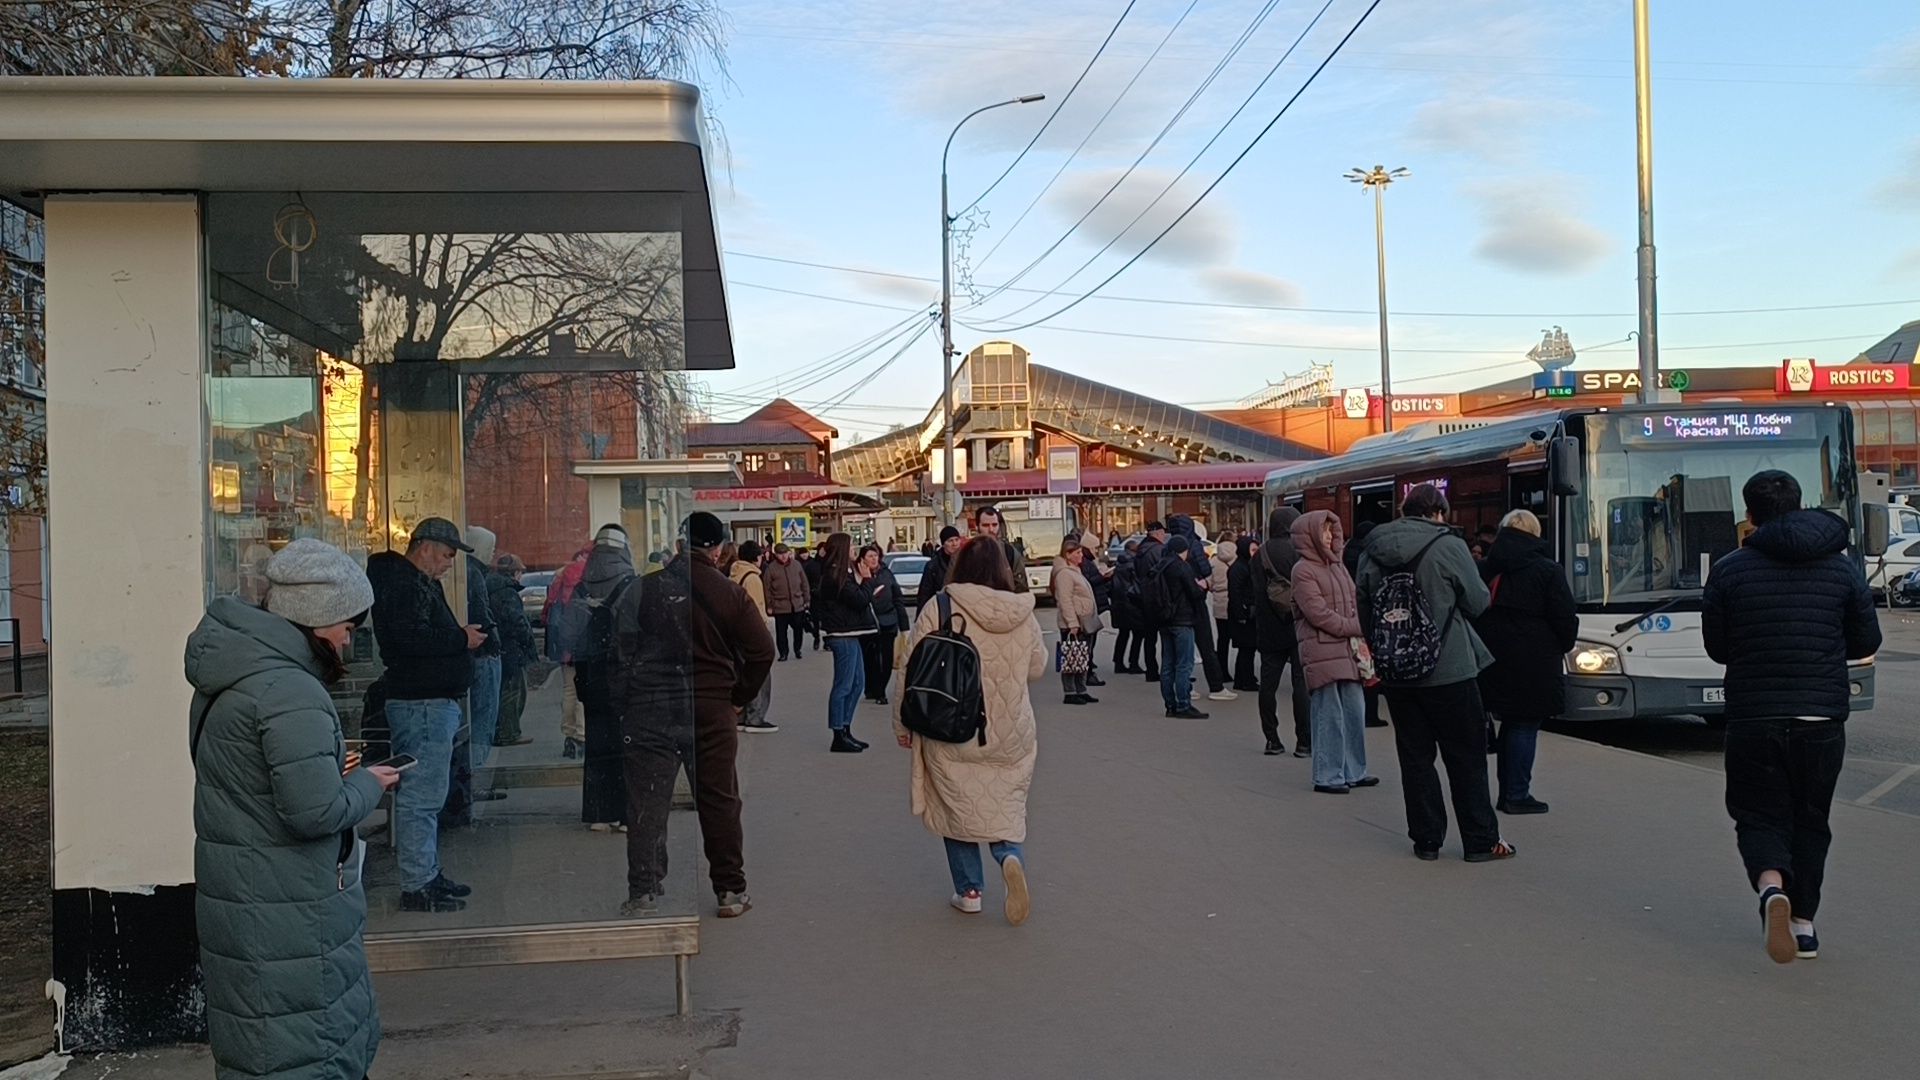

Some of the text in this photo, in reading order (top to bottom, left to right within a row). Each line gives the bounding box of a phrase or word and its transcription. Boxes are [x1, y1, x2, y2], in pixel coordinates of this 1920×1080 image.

[1829, 369, 1895, 385] ROSTIC'S
[1643, 417, 1653, 436] 9
[1664, 413, 1792, 428] Станция МЦД Лобня
[1675, 424, 1782, 438] Красная Поляна
